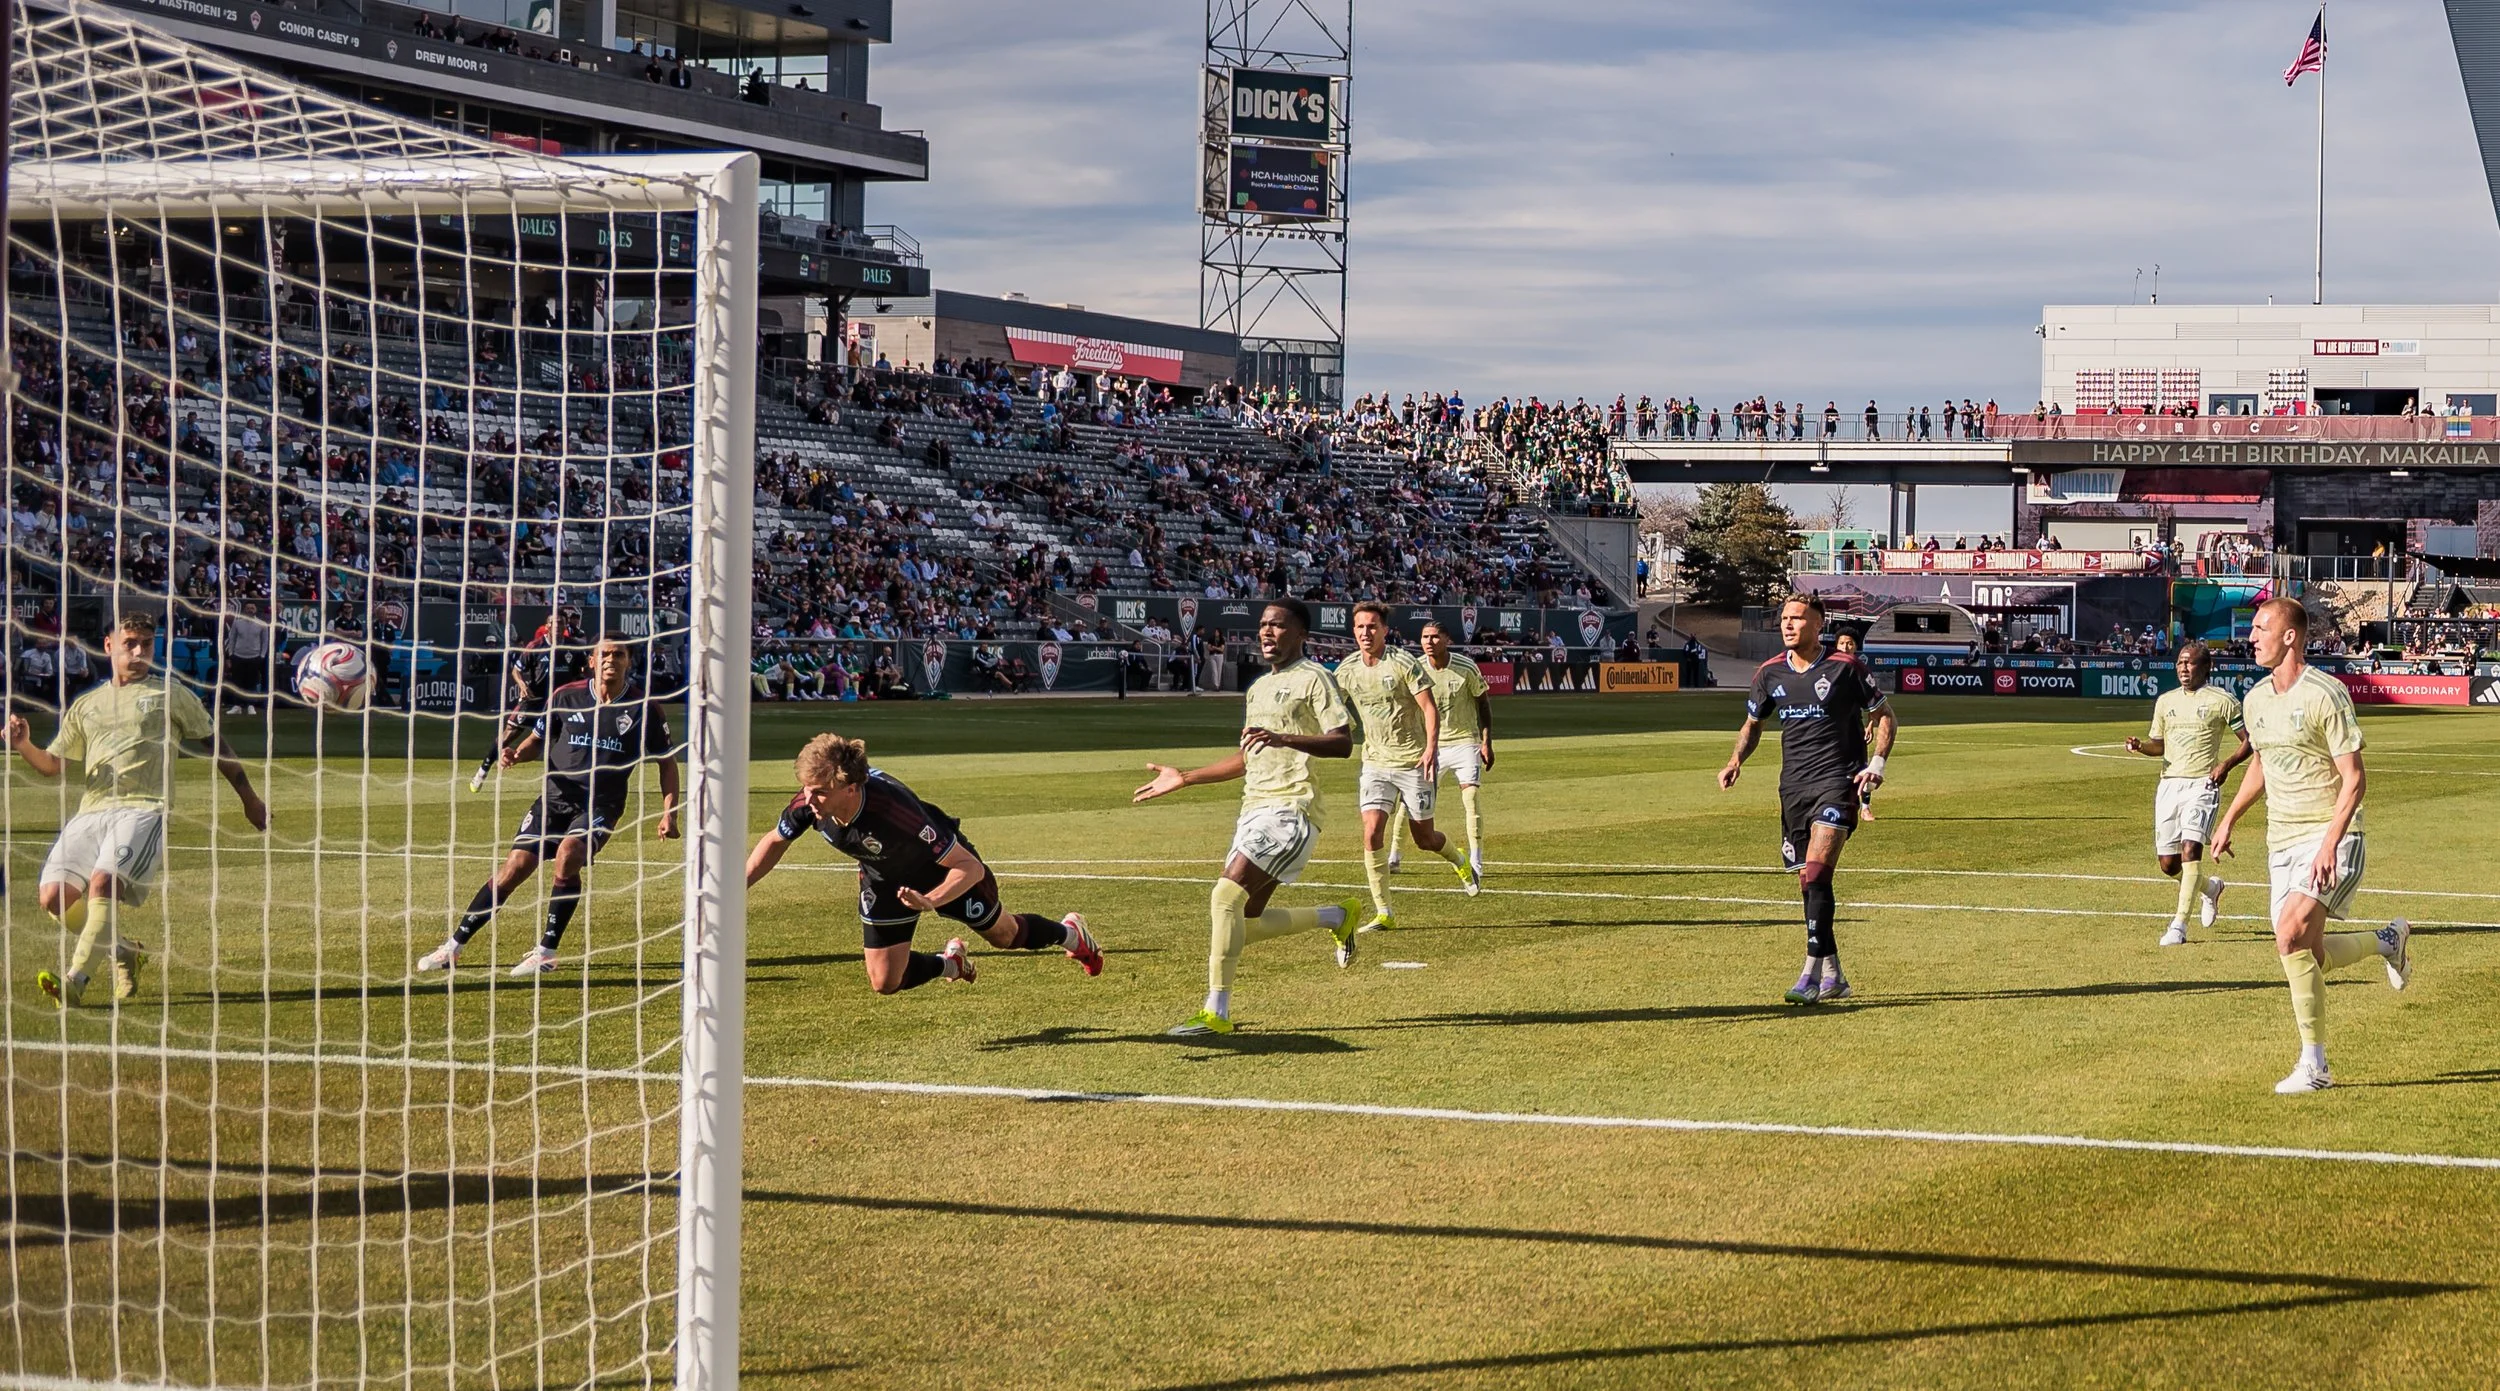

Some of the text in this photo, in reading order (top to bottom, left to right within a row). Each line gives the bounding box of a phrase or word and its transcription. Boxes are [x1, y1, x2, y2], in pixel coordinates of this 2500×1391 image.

[158, 0, 221, 17] MASTROENI
[279, 20, 315, 38] CONOR
[317, 29, 349, 45] CASEY
[415, 49, 445, 65] DREW
[447, 56, 477, 72] MOOR
[1236, 87, 1325, 123] DICK'S
[1251, 171, 1319, 183] HCA HealthONE
[1073, 338, 1123, 368] Freddy's
[2093, 444, 2171, 462] HAPPY
[2178, 444, 2237, 463] 14TH
[2246, 445, 2371, 465] BIRTHDAY,
[2380, 445, 2491, 465] MAKAILA
[1116, 601, 1146, 619] DICK'S
[1321, 606, 1346, 624] DICK'S
[1500, 612, 1521, 627] DICK'S
[620, 613, 661, 636] DICKS
[1087, 647, 1118, 658] uchealth
[1607, 666, 1674, 689] Continental Tire
[1929, 674, 1983, 687] TOYOTA
[2021, 676, 2075, 688] TOYOTA
[2101, 674, 2158, 696] DICK'S
[2371, 685, 2461, 696] EXTRAORDINARY
[2188, 807, 2207, 829] 21
[115, 845, 133, 868] 9
[966, 897, 985, 919] 6
